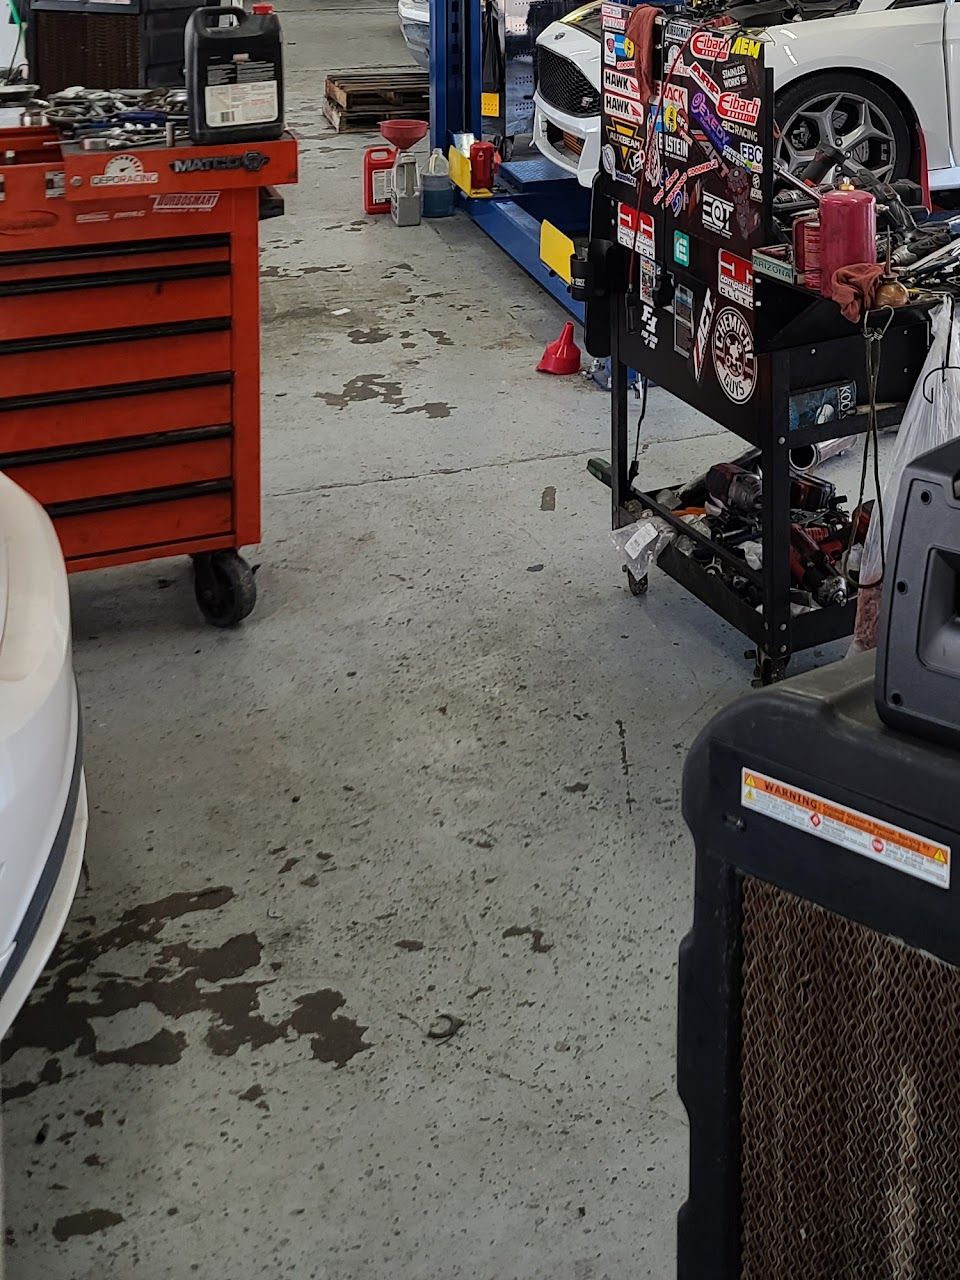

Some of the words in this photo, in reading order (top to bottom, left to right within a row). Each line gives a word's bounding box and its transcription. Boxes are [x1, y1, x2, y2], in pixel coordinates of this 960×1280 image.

[692, 33, 731, 56] Eibach
[730, 36, 761, 59] AEM
[605, 71, 629, 91] HAWK
[690, 64, 720, 94] ARP
[722, 65, 746, 79] STAINLESS
[723, 76, 740, 89] WORKS
[606, 96, 630, 114] HAWK
[718, 93, 760, 118] Eibach
[699, 102, 730, 143] EXEDY
[735, 125, 758, 142] RACING
[741, 142, 763, 164] EBC
[173, 158, 239, 172] MATCO
[91, 172, 159, 185] DEPORACING
[152, 192, 220, 208] TURBOSMART
[753, 259, 792, 280] ARIZONA
[715, 312, 754, 363] CHEMICAL
[722, 373, 746, 397] GUYS
[764, 779, 818, 810] WARNING
